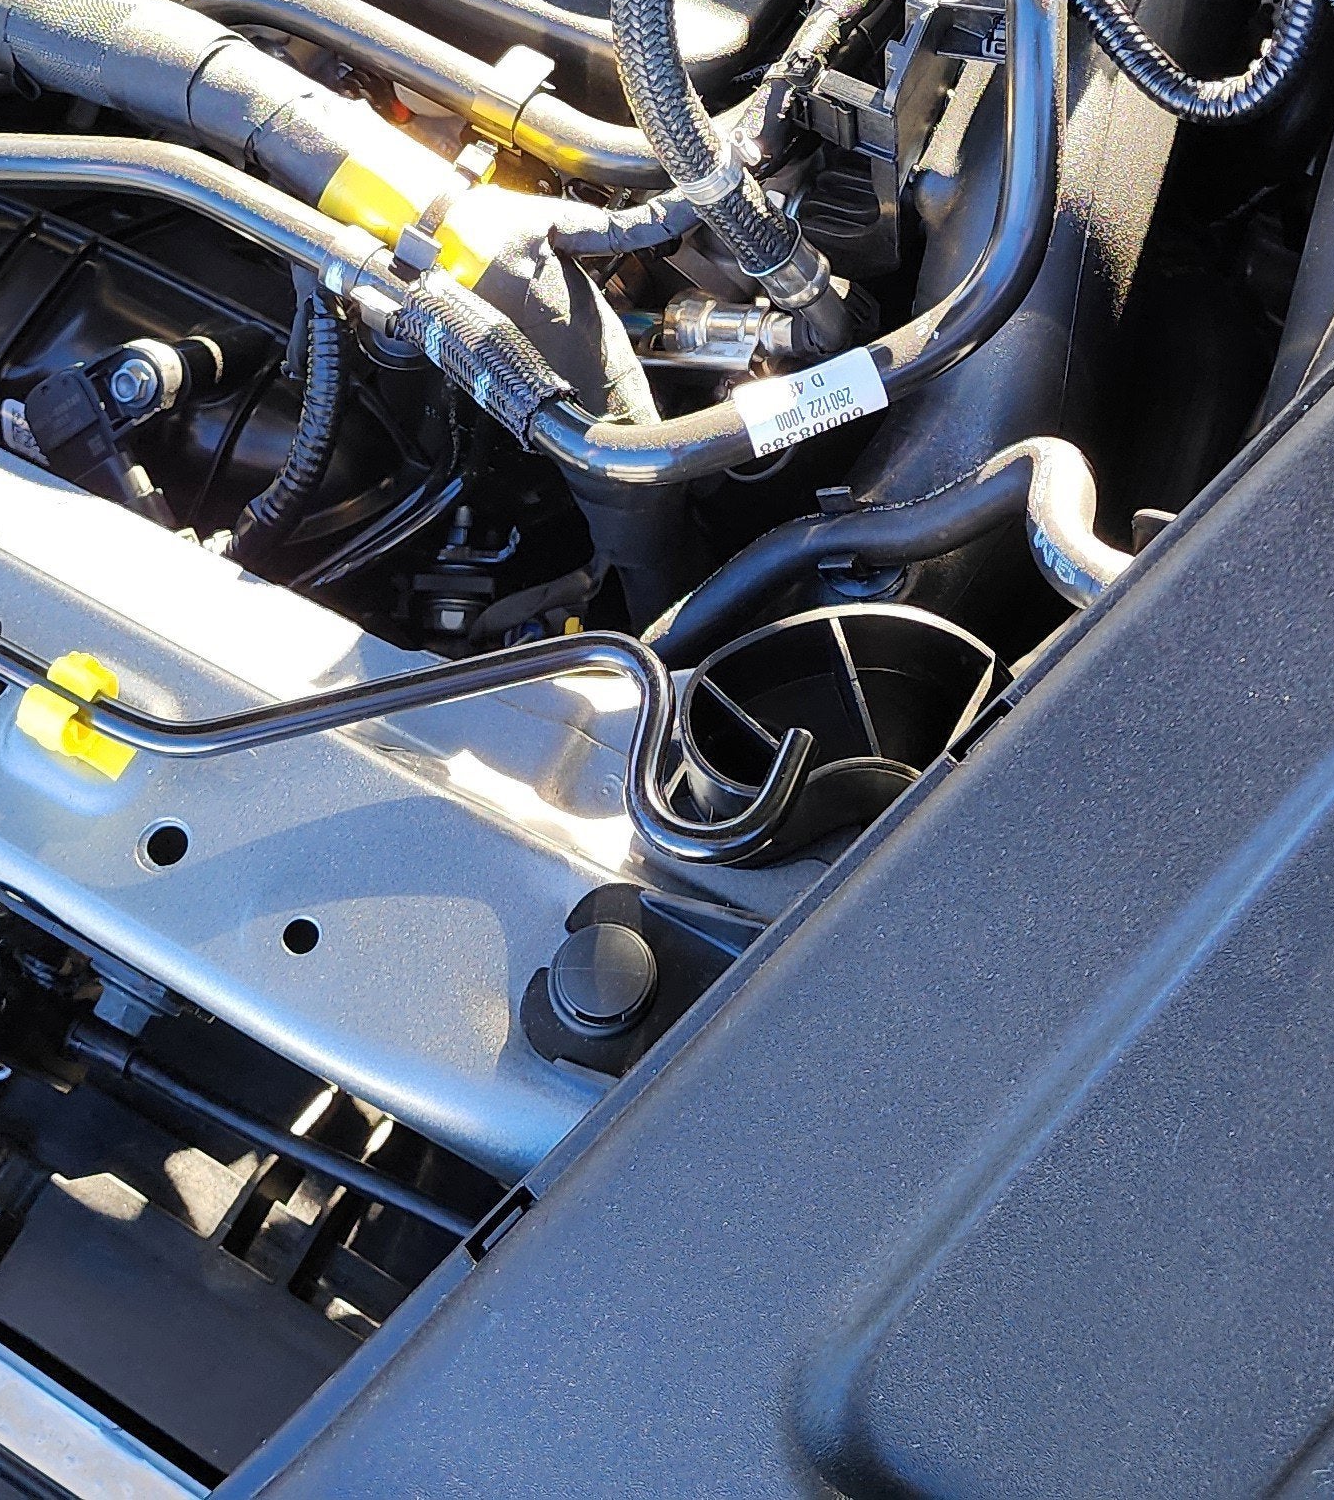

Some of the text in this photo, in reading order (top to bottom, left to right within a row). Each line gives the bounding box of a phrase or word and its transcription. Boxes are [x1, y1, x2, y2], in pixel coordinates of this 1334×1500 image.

[811, 372, 825, 388] D
[775, 386, 855, 432] 260122 1000
